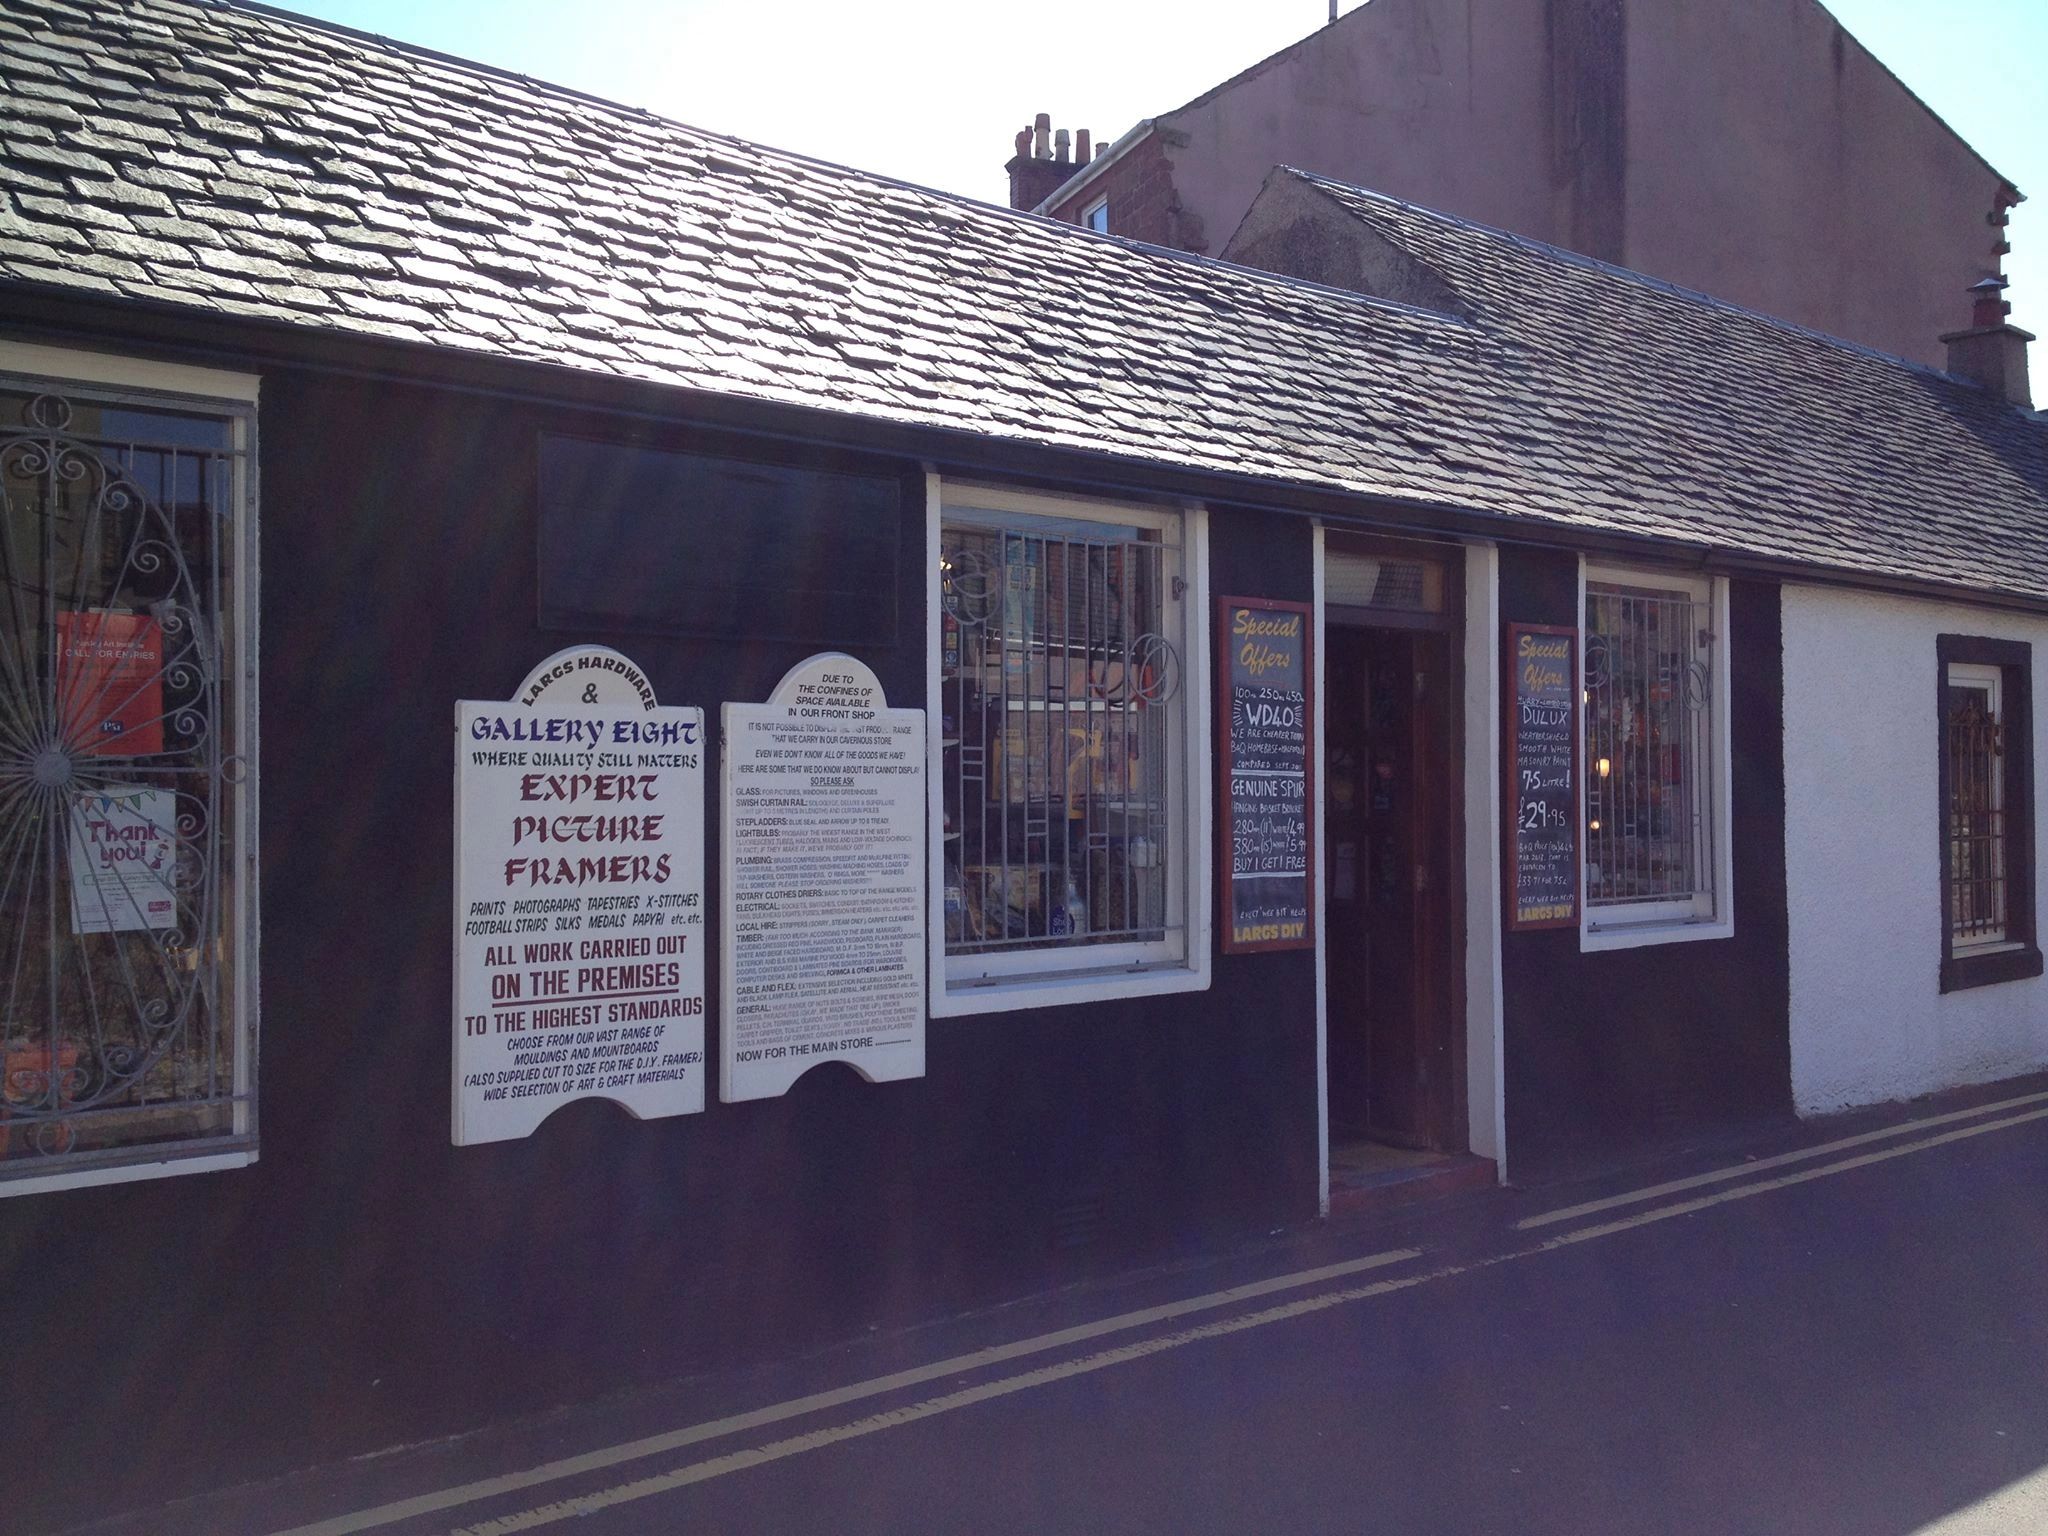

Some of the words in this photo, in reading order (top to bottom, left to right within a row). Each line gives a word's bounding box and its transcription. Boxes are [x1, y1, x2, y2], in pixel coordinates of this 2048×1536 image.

[1233, 610, 1299, 640] Special
[95, 650, 113, 658] OR
[115, 650, 155, 660] ENRIES
[1519, 635, 1568, 663] Special
[1240, 642, 1290, 676] Offers
[522, 661, 574, 707] LARGS
[578, 657, 656, 711] HARDWARE
[823, 675, 840, 683] DUE
[842, 675, 853, 684] TO
[1524, 664, 1563, 693] Offers
[582, 683, 598, 703] &
[799, 685, 815, 694] THE
[817, 686, 859, 695] CONFINES
[796, 696, 824, 705] SPACE
[826, 698, 870, 707] AVAILABLE
[789, 708, 796, 716] IN
[801, 709, 819, 717] OUR
[821, 709, 850, 719] FRONT
[852, 711, 875, 719] SHOP
[1246, 703, 1294, 727] WD40
[1523, 707, 1567, 725] DULUX
[472, 717, 604, 749] GALLERY
[612, 720, 697, 745] EIGHT
[788, 735, 798, 743] WE
[798, 735, 817, 743] CARRY
[819, 735, 824, 743] IN
[826, 735, 837, 743] OUR
[839, 735, 872, 744] CAVERNOUS
[873, 736, 891, 744] STORE
[1231, 728, 1244, 739] WE
[1247, 728, 1261, 738] ARE
[755, 749, 772, 758] EVEN
[773, 749, 782, 758] WE
[804, 750, 822, 758] KNOW
[824, 750, 834, 758] ALL
[836, 750, 844, 758] OF
[846, 750, 856, 758] THE
[857, 750, 878, 759] GOODS
[879, 751, 887, 759] WE
[1518, 744, 1548, 753] SMOOTH
[1551, 745, 1572, 753] WHITE
[472, 750, 527, 766] WHERE
[532, 752, 593, 770] QUALITY
[597, 752, 632, 767] STILL
[637, 754, 697, 768] MATTERS
[737, 764, 753, 773] HERE
[755, 764, 767, 773] ARE
[769, 764, 785, 773] SOME
[787, 765, 802, 773] THAT
[803, 765, 812, 773] WE
[814, 765, 822, 773] DO
[823, 765, 841, 773] KNOW
[842, 765, 862, 773] ABOUT
[863, 765, 873, 773] BUT
[875, 765, 897, 773] CANNOT
[520, 773, 658, 803] EXPERT
[810, 776, 818, 785] SO
[820, 776, 841, 785] PLEASE
[843, 776, 854, 785] ASK
[1232, 778, 1278, 797] GENUINE
[735, 787, 761, 795] GLASS:
[735, 798, 758, 807] SWISH
[759, 798, 789, 806] CURTAIN
[1260, 803, 1281, 813] BASKET
[89, 819, 160, 842] Thank
[513, 814, 664, 845] PICTURE
[735, 817, 788, 826] STEPLADDERS:
[735, 828, 780, 837] LIGHTBULBS:
[735, 856, 772, 865] PLUMBING:
[1234, 857, 1252, 872] BUY
[1261, 857, 1277, 870] GET
[1286, 856, 1306, 870] FREE
[504, 853, 670, 887] FRAMERS
[735, 891, 763, 900] ROTARY
[765, 890, 796, 899] CLOTHES
[797, 888, 823, 897] DRIERS:
[470, 900, 505, 915] PRINTS
[512, 897, 580, 914] PHOTOGRAPHS
[587, 895, 639, 910] TAPESTRIES
[646, 893, 698, 907] X-STITCHES
[1517, 907, 1552, 922] LARGS
[1554, 905, 1572, 918] DIY
[465, 919, 511, 935] FOOTBALL
[514, 917, 548, 932] STRIPS
[554, 915, 581, 930] SILKS
[588, 913, 626, 928] MEDALS
[632, 912, 664, 926] PAPYRI
[671, 913, 685, 924] etc.
[687, 913, 701, 923] etc.
[735, 922, 759, 931] LOCAL
[736, 933, 763, 943] TIMBER:
[1233, 925, 1278, 943] LARGS
[1282, 923, 1304, 938] DIY
[484, 945, 516, 966] ALL
[524, 941, 572, 963] WORK
[580, 937, 650, 959] CARRIED
[656, 935, 686, 954] OUT
[826, 967, 850, 976] FORMICA
[856, 966, 874, 974] OTHER
[875, 963, 904, 972] LAMINATES
[492, 973, 520, 999] ON
[529, 969, 568, 996] THE
[578, 962, 678, 992] PREMISES
[736, 985, 759, 995] CABLE
[761, 984, 776, 993] AND
[465, 1015, 486, 1035] TO
[494, 1011, 525, 1032] THE
[532, 1004, 601, 1029] HIGHEST
[608, 996, 701, 1022] STANDARDS
[507, 1035, 544, 1050] CHOOSE
[546, 1033, 574, 1046] FROM
[576, 1031, 594, 1044] OUR
[596, 1029, 618, 1042] VAST
[620, 1026, 651, 1039] RANGE
[653, 1024, 665, 1036] OF
[514, 1048, 568, 1065] MOULDINGS
[570, 1047, 590, 1059] AND
[592, 1040, 658, 1057] MOUNTBOARDS
[736, 1049, 762, 1062] NOW
[765, 1046, 786, 1059] FOR
[789, 1043, 809, 1056] THE
[811, 1040, 837, 1053] MAIN
[840, 1036, 872, 1050] STORE
[464, 1072, 494, 1086] (ALSO
[496, 1067, 540, 1083] SUPPLIED
[542, 1065, 560, 1078] CUT
[562, 1064, 573, 1076] TO
[575, 1061, 596, 1075] SIZE
[598, 1059, 616, 1072] FOR
[618, 1057, 634, 1070] THE
[483, 1086, 508, 1100] WIDE
[510, 1081, 560, 1098] SELECTION
[562, 1080, 574, 1092] OF
[577, 1077, 595, 1090] ART
[597, 1076, 604, 1088] &
[606, 1073, 634, 1087] CRAFT
[637, 1068, 684, 1083] MATERIALS
